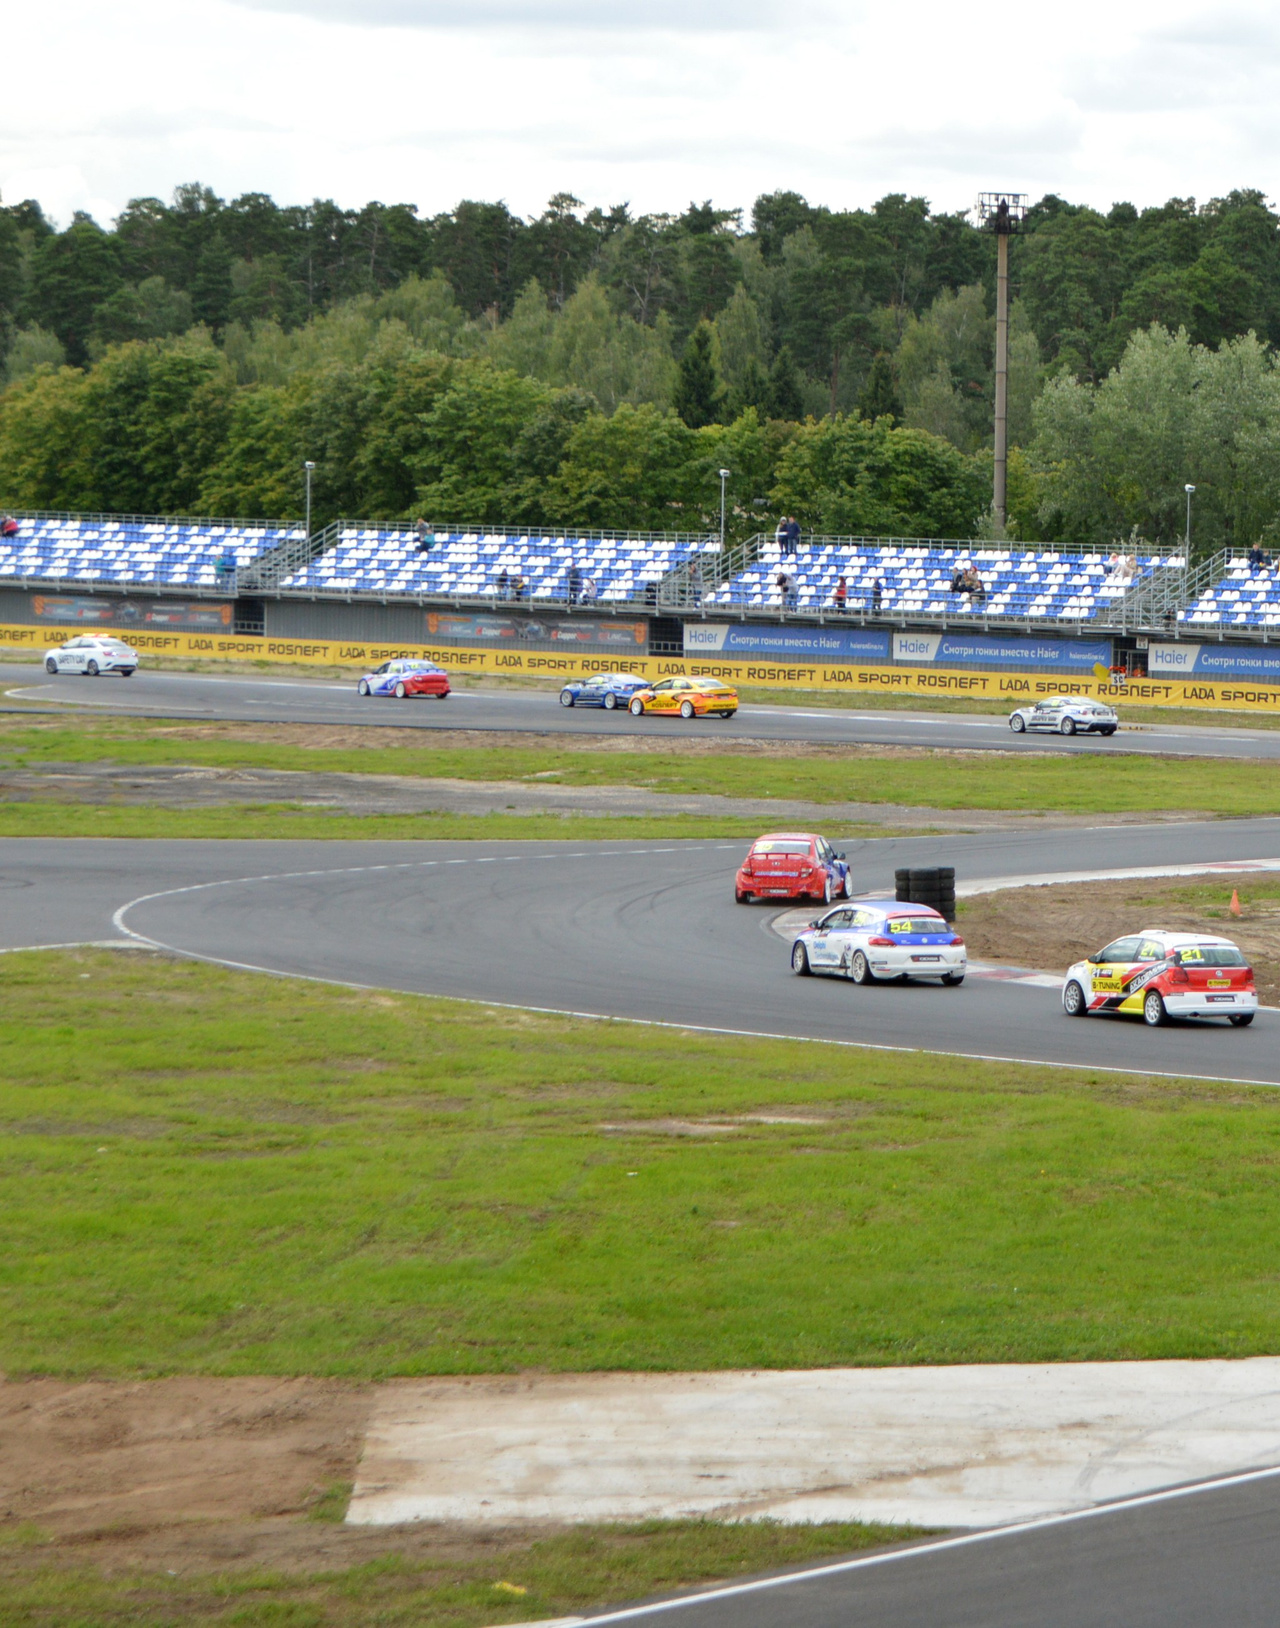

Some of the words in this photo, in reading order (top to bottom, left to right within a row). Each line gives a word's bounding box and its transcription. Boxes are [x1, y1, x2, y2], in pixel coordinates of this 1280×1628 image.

[44, 631, 68, 643] LADA
[689, 630, 718, 644] Haier
[729, 632, 760, 647] Смотри
[761, 637, 783, 646] гонки
[784, 638, 812, 647] вместе
[819, 635, 841, 649] Haier
[188, 638, 214, 651] LADA
[217, 642, 264, 653] SPORT
[268, 643, 329, 657] ROSNEFT
[899, 639, 930, 654] Haier
[942, 643, 974, 657] Смотри
[975, 647, 999, 657] гонки
[1037, 647, 1059, 659] Haier
[339, 647, 366, 659] LADA
[370, 649, 418, 660] SPORT
[422, 651, 487, 665] ROSNEFT
[1155, 650, 1188, 664] Haier
[1201, 654, 1235, 668] Смотри
[1236, 658, 1262, 668] гонки
[495, 655, 523, 668] LADA
[527, 658, 577, 670] SPORT
[581, 659, 648, 674] ROSNEFT
[657, 663, 686, 675] LADA
[690, 666, 743, 678] SPORT
[747, 667, 816, 682] ROSNEFT
[823, 670, 853, 683] LADA
[858, 673, 913, 685] SPORT
[917, 674, 990, 689] ROSNEFT
[999, 679, 1030, 692] LADA
[1035, 682, 1093, 694] SPORT
[1097, 683, 1173, 698] ROSNEFT
[1183, 687, 1216, 700] LADA
[890, 921, 912, 933] 54
[1180, 949, 1202, 960] 21
